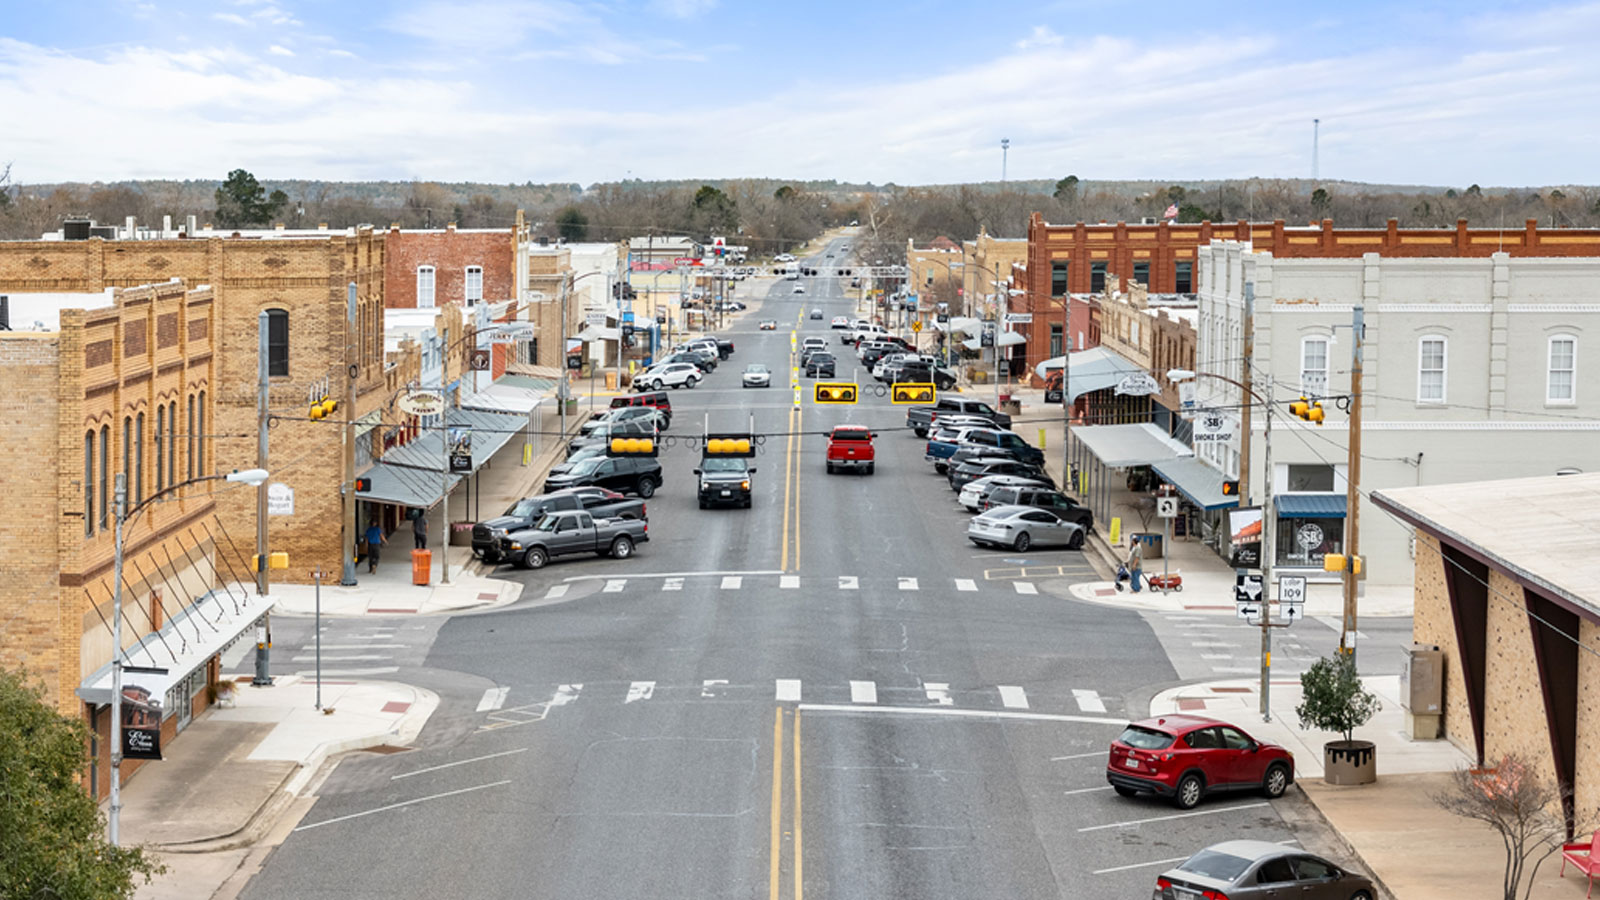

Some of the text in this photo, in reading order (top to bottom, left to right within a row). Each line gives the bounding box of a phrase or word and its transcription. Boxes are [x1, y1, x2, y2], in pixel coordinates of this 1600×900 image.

[1207, 418, 1219, 427] SB
[1194, 433, 1232, 441] SMOKE SHOP
[1302, 531, 1317, 543] SB
[1284, 588, 1301, 598] 109
